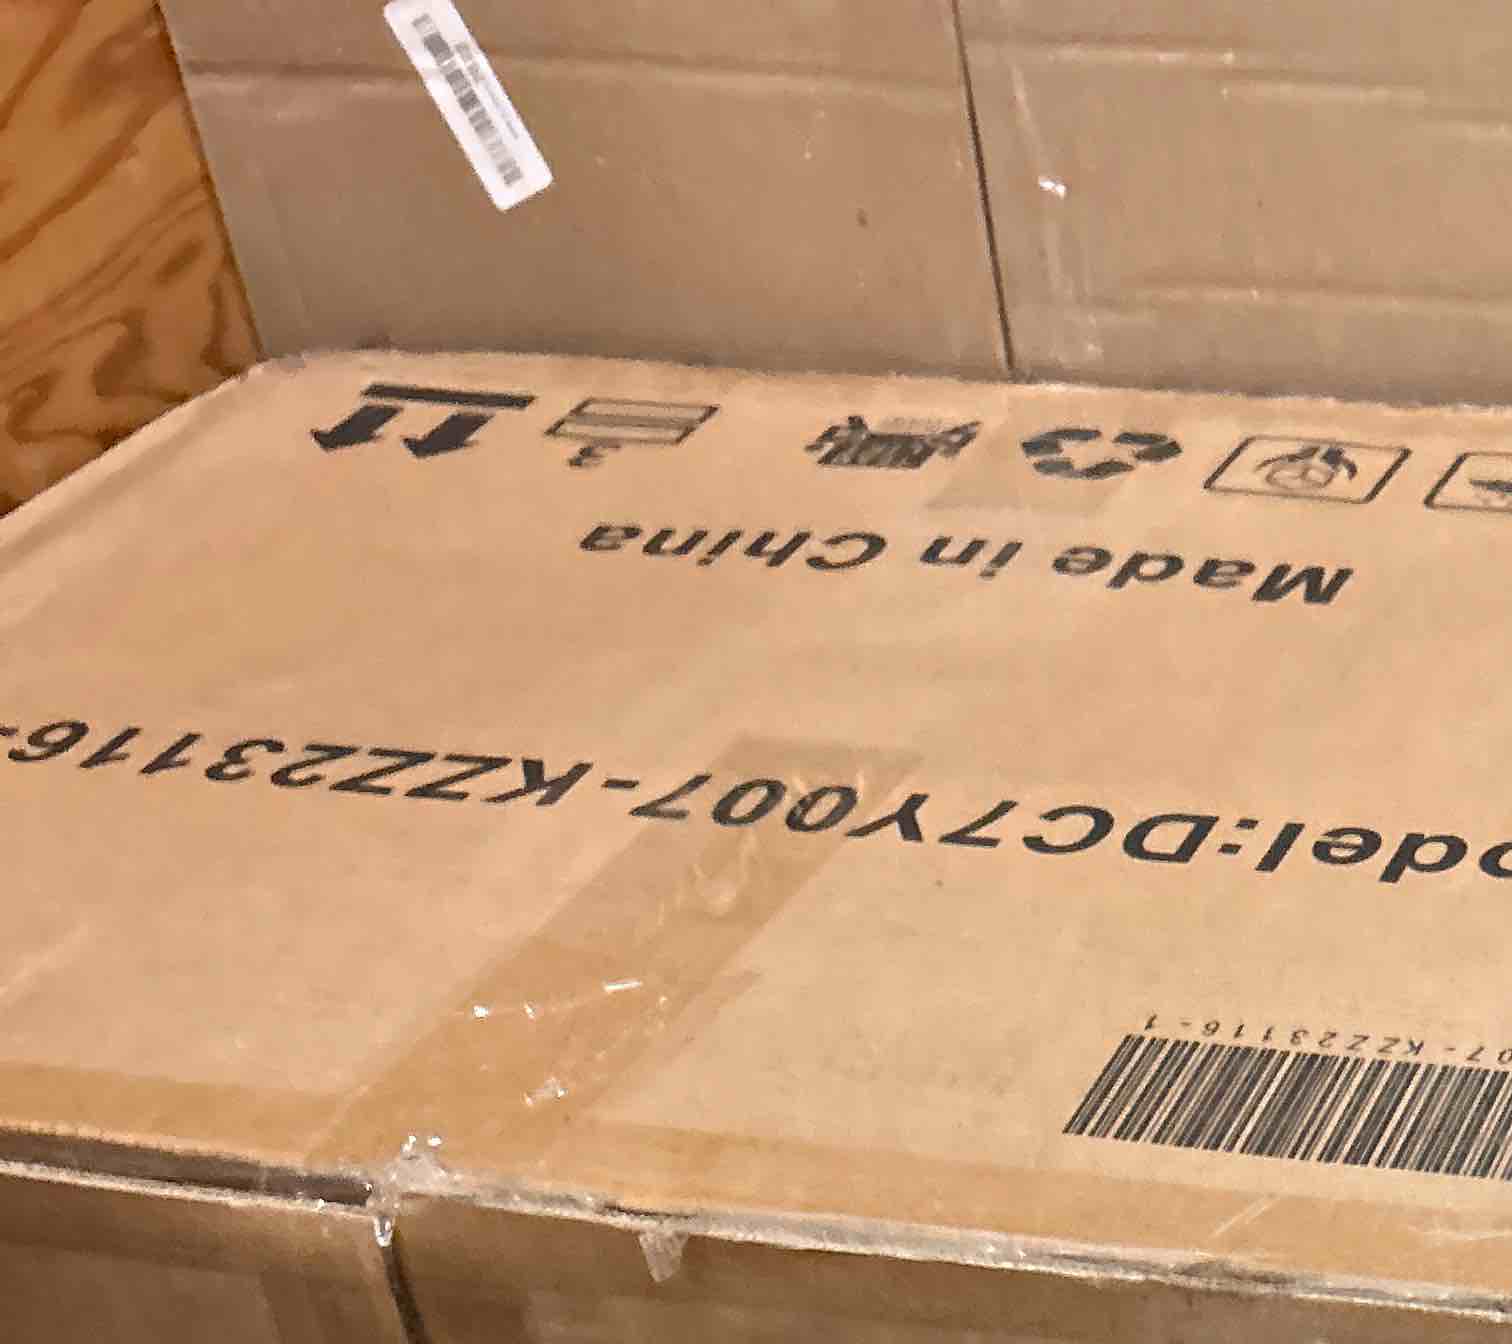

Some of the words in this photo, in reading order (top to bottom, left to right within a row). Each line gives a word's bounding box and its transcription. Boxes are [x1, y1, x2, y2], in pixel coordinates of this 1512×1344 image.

[577, 521, 888, 571] China
[919, 535, 1025, 578] in
[1052, 542, 1354, 605] Made
